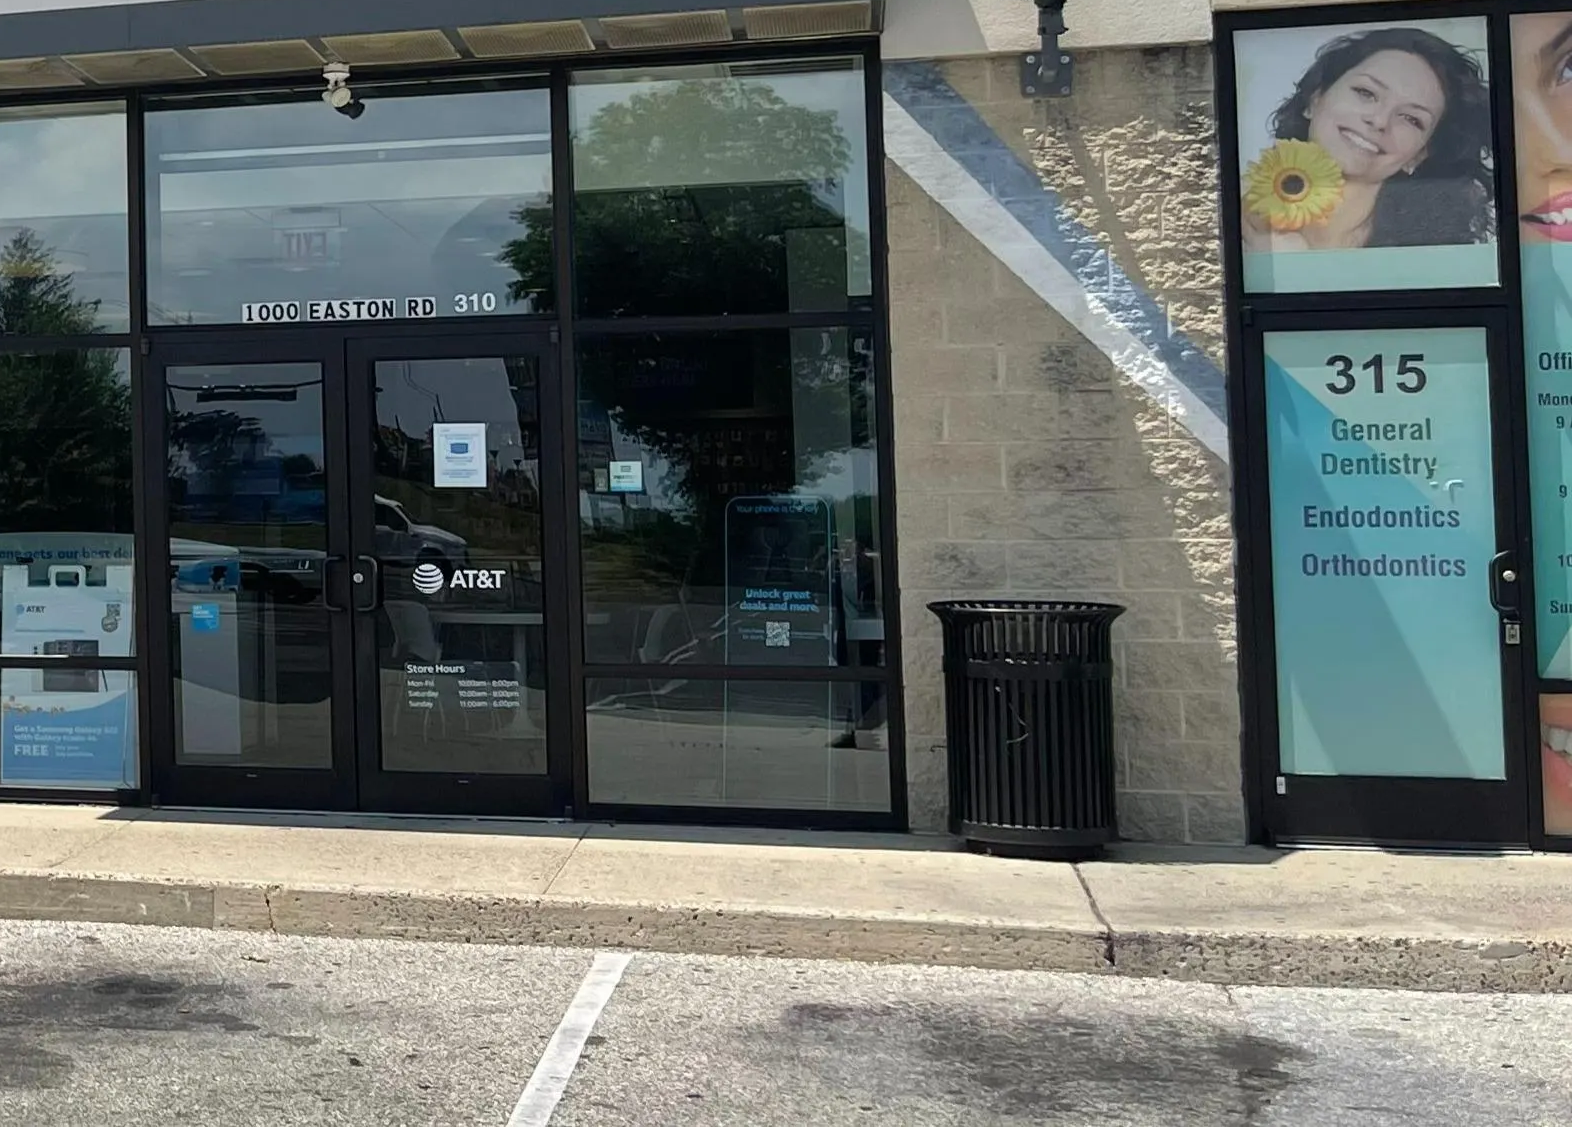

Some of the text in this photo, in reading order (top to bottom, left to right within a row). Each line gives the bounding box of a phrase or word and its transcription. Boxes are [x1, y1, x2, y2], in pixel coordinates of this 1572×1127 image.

[246, 292, 496, 322] 1000 EASTON RD 310
[1325, 353, 1426, 395] 315
[1538, 393, 1572, 406] Mon
[1556, 416, 1565, 429] 9
[1331, 417, 1432, 442] General
[1321, 453, 1437, 479] Dentistry
[1559, 484, 1567, 498] 9
[1303, 505, 1460, 529] Endodontics
[57, 549, 78, 560] our
[1301, 553, 1466, 577] Orthodontics
[450, 569, 506, 589] AT&T
[745, 588, 810, 601] Unlock great
[25, 605, 46, 614] AT&T
[740, 601, 767, 610] deals
[769, 601, 787, 610] and
[407, 664, 466, 673] Store Hours
[408, 690, 439, 698] Saturday
[409, 701, 433, 709] Sunday
[13, 744, 49, 756] FREE
